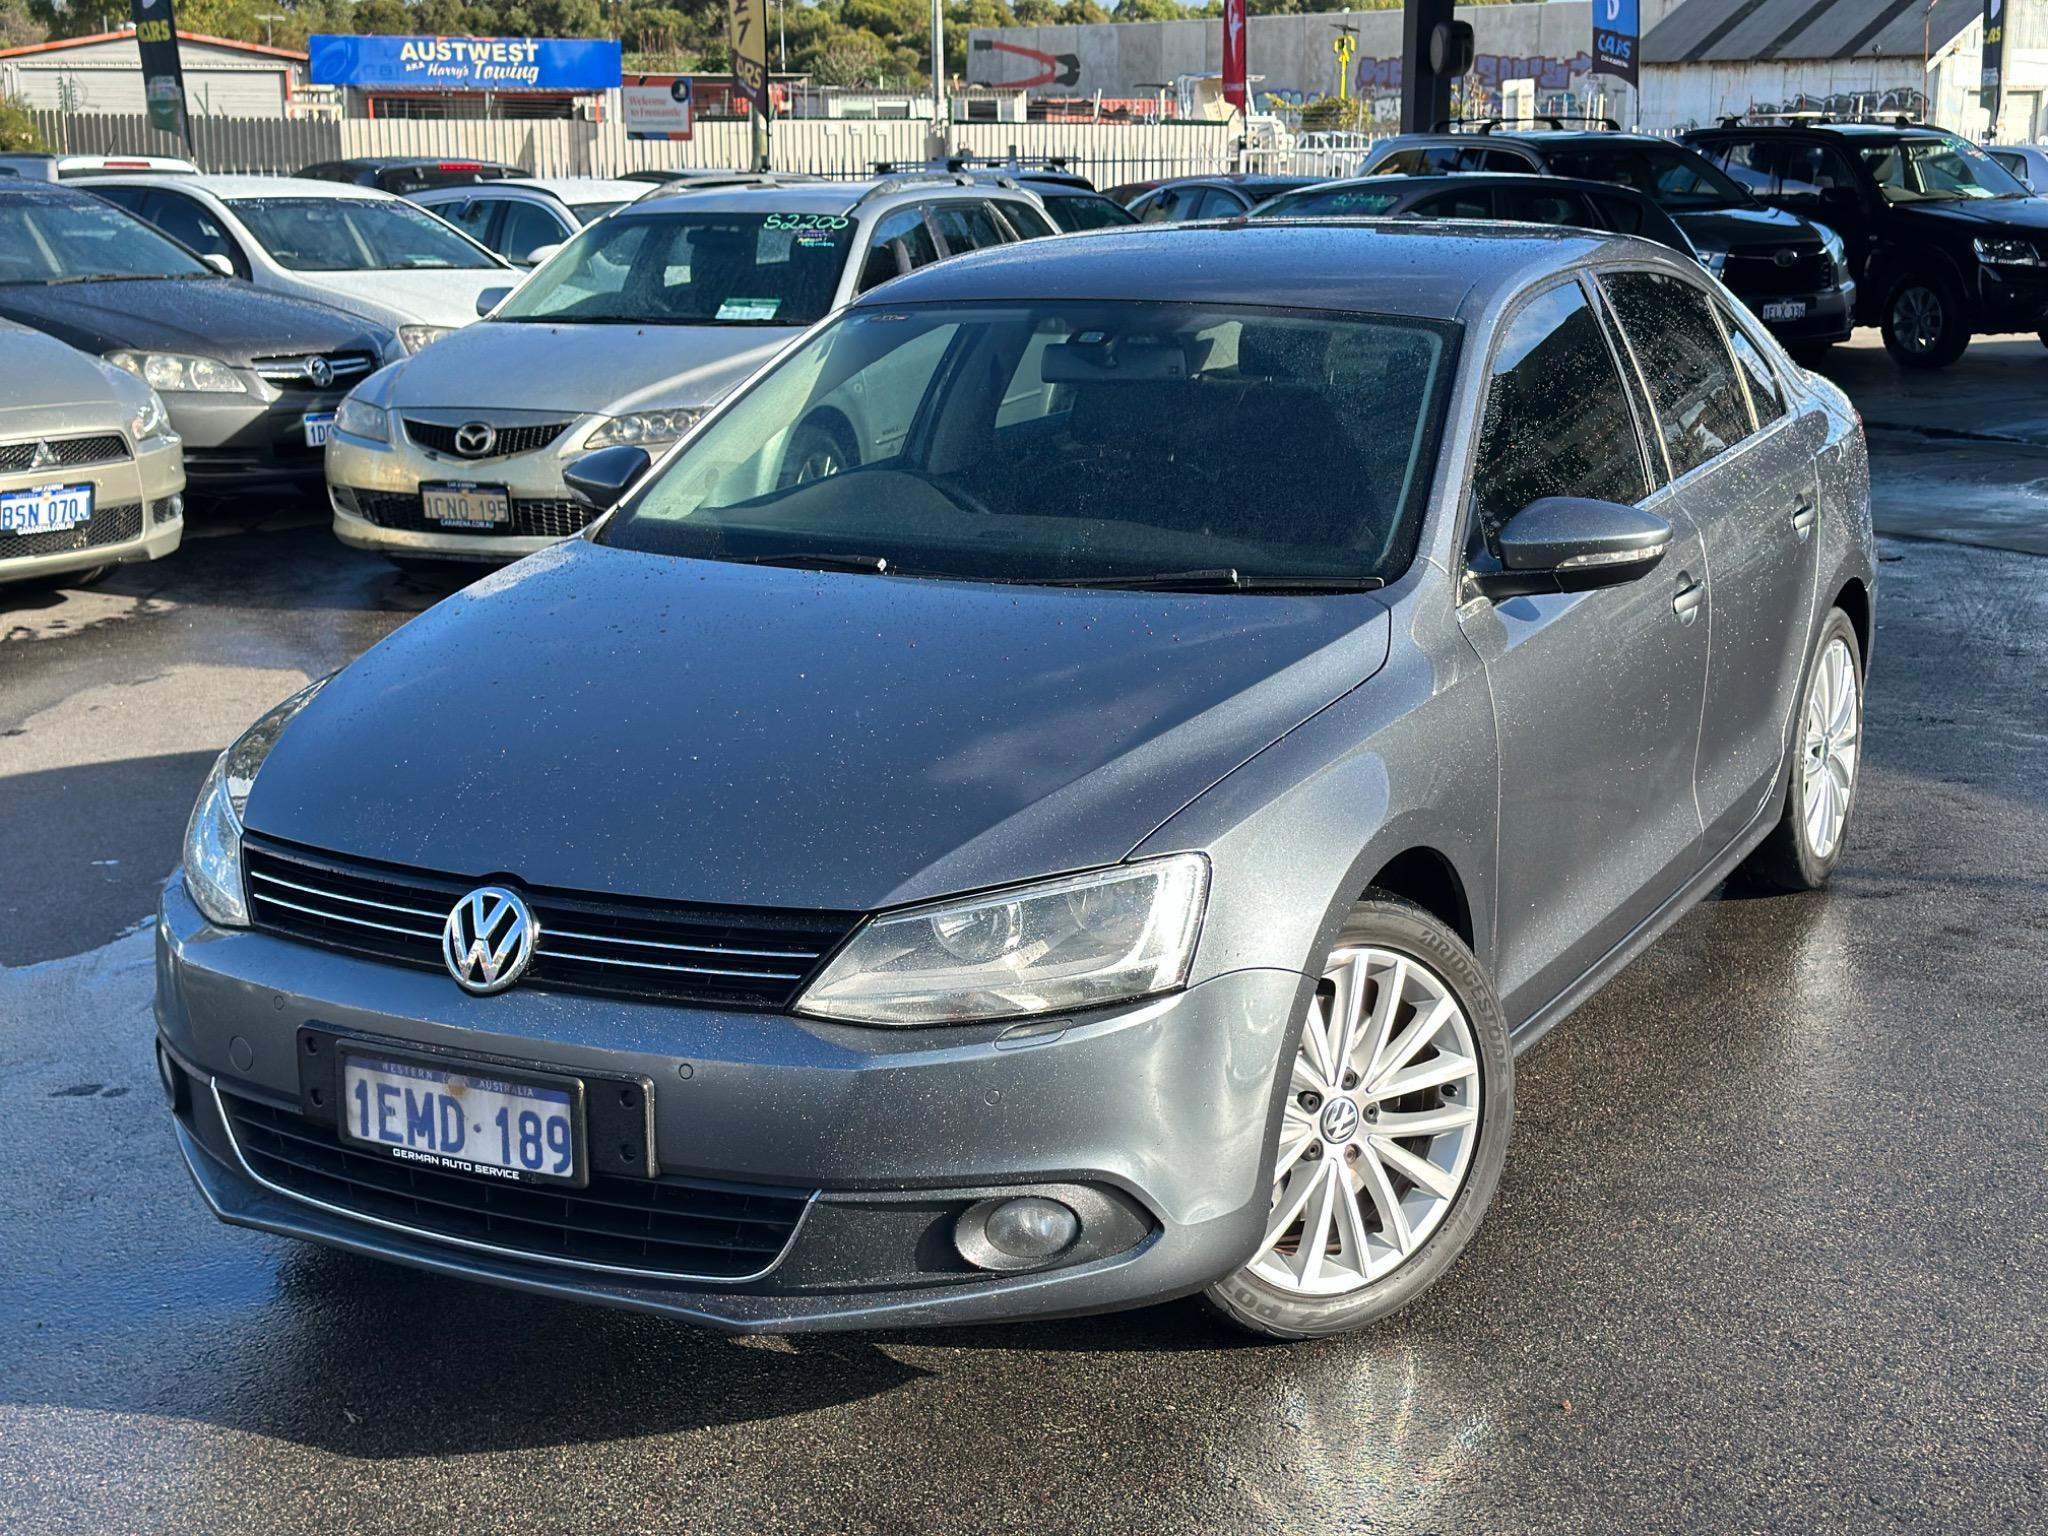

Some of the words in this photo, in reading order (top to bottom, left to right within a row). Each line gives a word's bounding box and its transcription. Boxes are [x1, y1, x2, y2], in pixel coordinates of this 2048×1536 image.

[401, 40, 539, 62] AUSTWEST
[428, 62, 469, 79] Harry's
[474, 60, 539, 84] Towing
[2, 503, 39, 530] BSN
[48, 496, 91, 524] 070J
[480, 499, 508, 522] 195
[381, 1062, 433, 1081] WESTERN
[479, 1079, 534, 1098] AUSTRALIA
[355, 1078, 465, 1154] 1EMD
[496, 1106, 571, 1175] 189
[393, 1147, 439, 1167] GERMAN
[442, 1157, 471, 1172] AUTO
[475, 1164, 520, 1181] SERVICE
